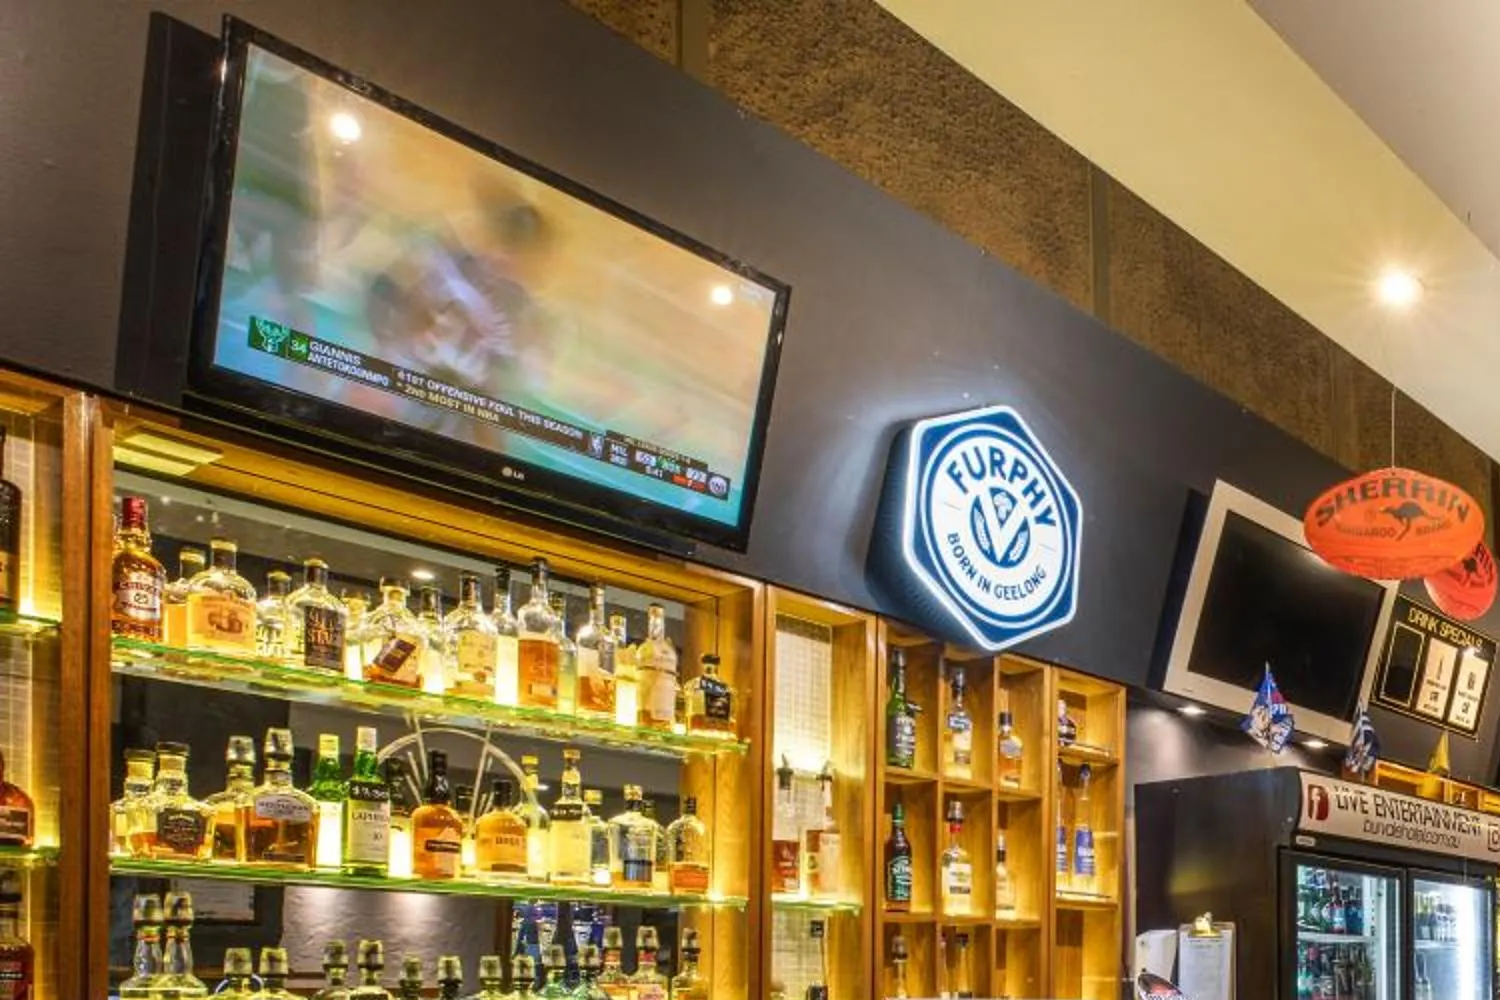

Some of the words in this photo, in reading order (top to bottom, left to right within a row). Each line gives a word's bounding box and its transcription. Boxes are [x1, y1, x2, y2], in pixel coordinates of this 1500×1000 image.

[309, 341, 362, 366] GIANNIS
[427, 379, 488, 407] OFFENSIVE
[428, 391, 460, 410] MOST
[463, 403, 475, 416] IN
[945, 445, 1057, 528] FURPHY
[1315, 477, 1470, 528] SHERRIN
[947, 532, 976, 582] BORN
[976, 574, 991, 595] IN
[993, 564, 1048, 602] GEELONG
[1407, 607, 1439, 634] DRINK
[1440, 621, 1483, 650] SPECIALS
[1334, 785, 1369, 815] LIVE
[1374, 794, 1482, 838] ENTERTAINMENT
